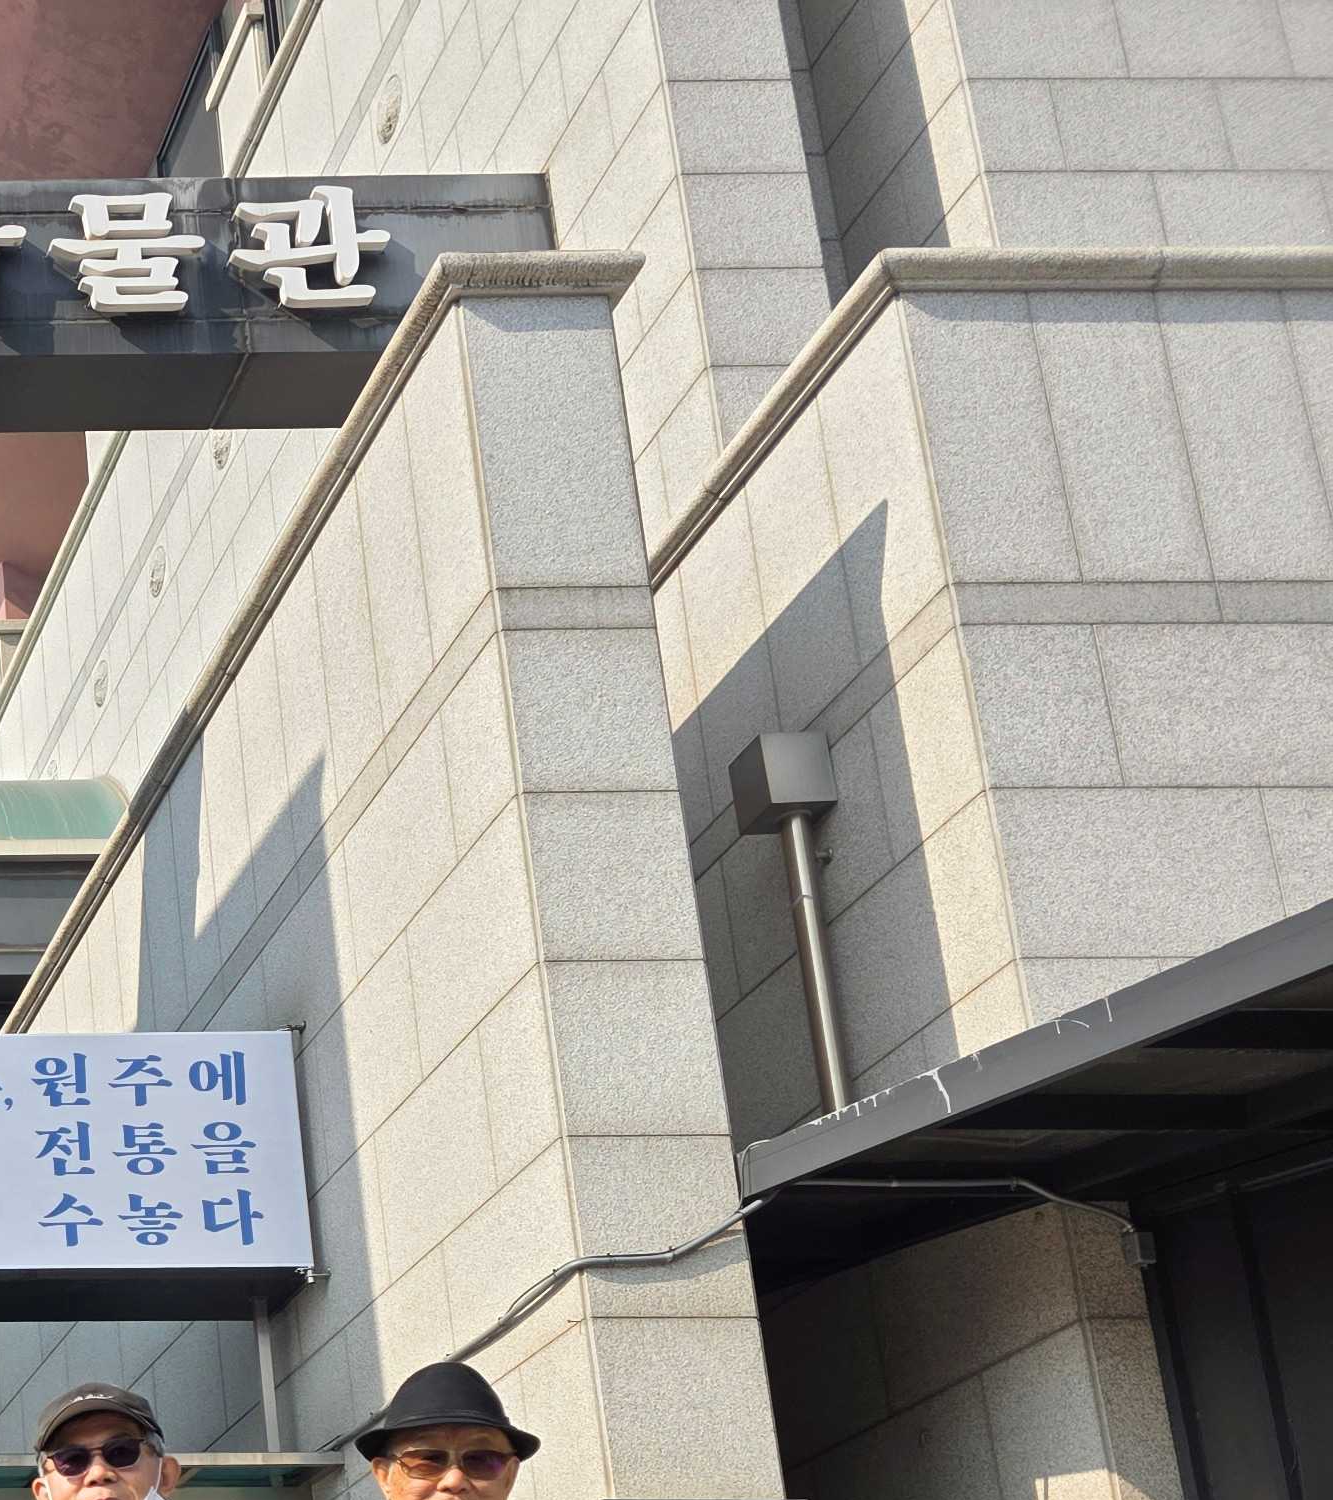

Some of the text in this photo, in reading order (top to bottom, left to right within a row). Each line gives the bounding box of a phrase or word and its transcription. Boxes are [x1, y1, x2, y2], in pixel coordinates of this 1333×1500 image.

[32, 1051, 249, 1109] 원주에
[35, 1122, 258, 1178] 전통을
[38, 1189, 265, 1248] 수놓다
